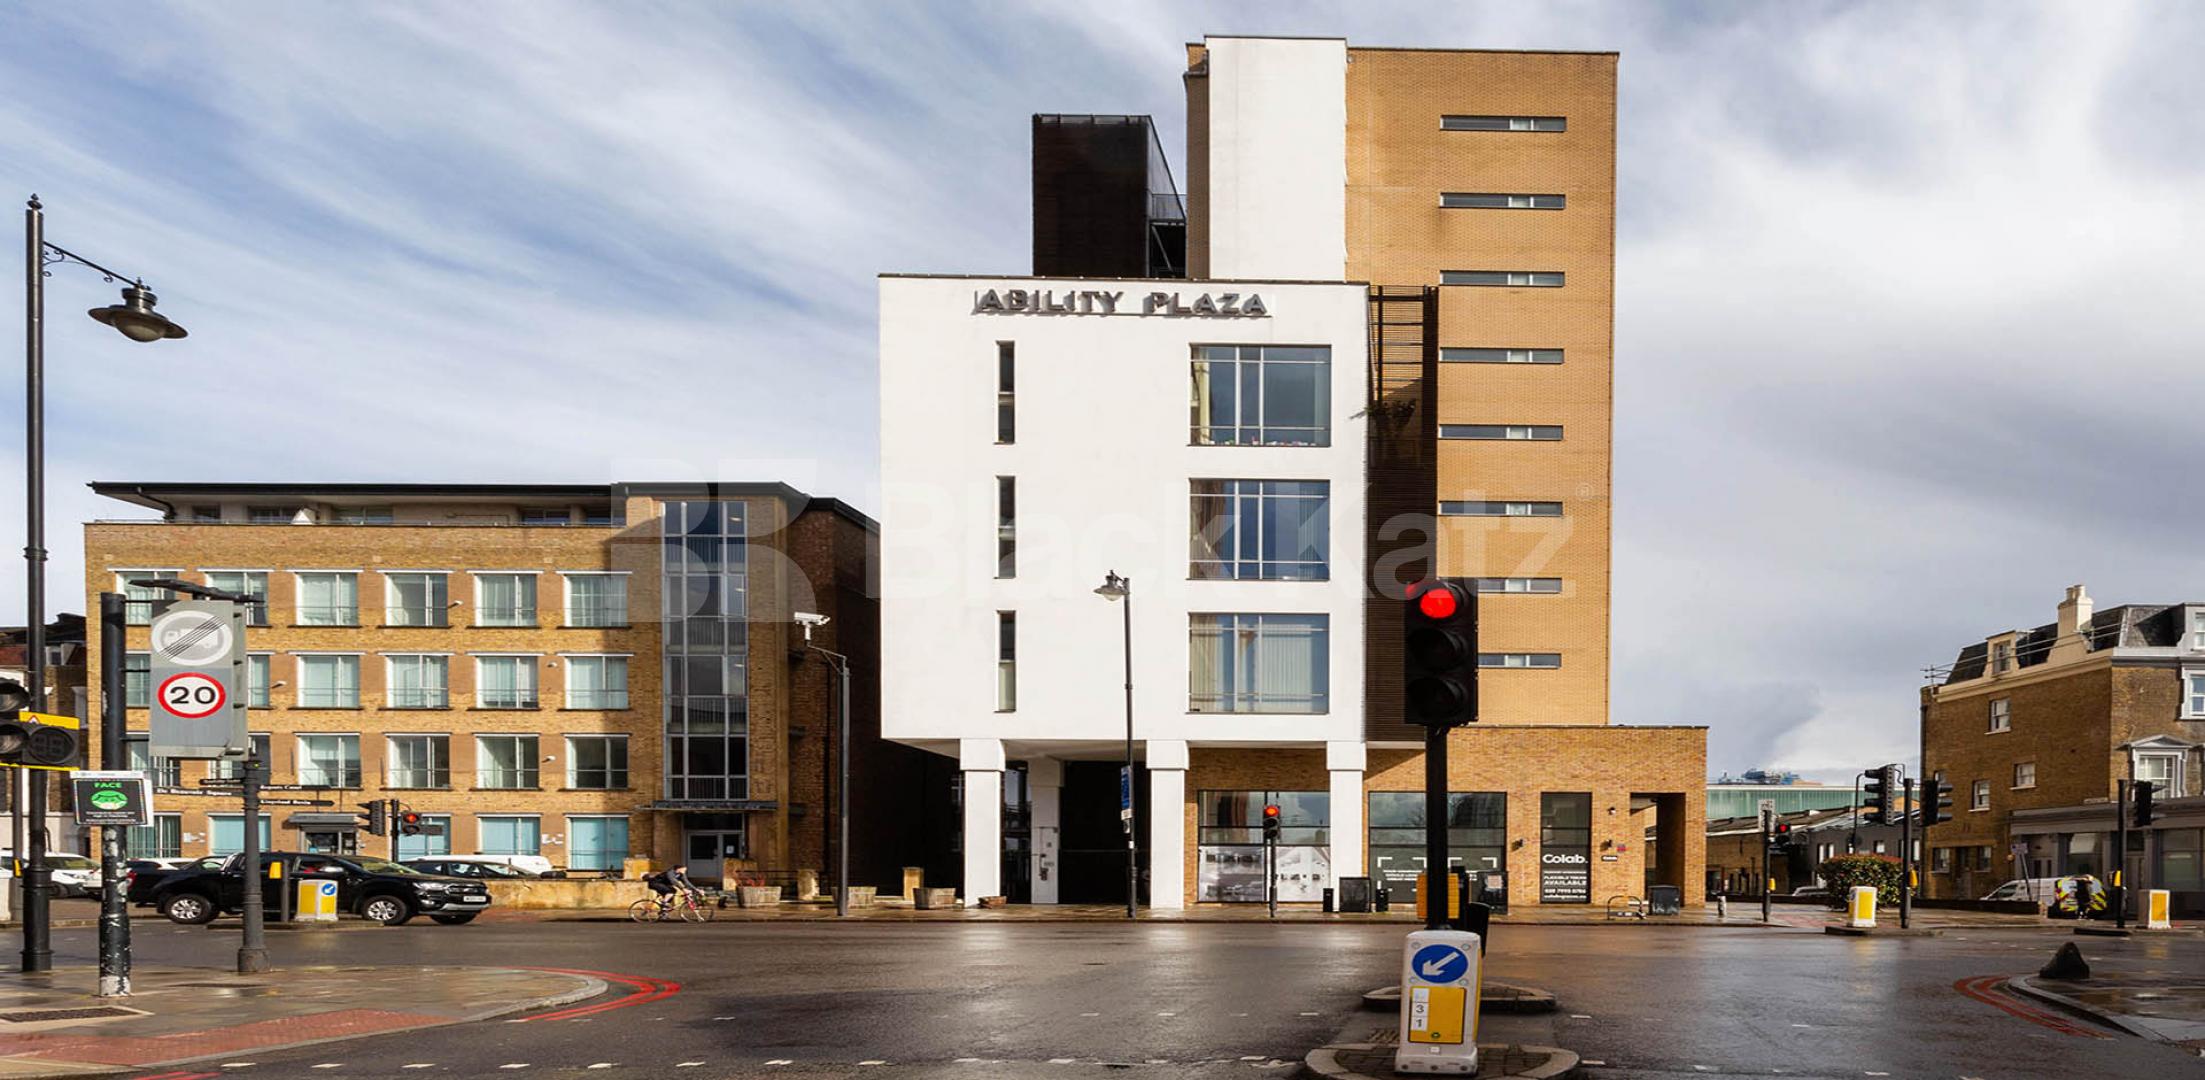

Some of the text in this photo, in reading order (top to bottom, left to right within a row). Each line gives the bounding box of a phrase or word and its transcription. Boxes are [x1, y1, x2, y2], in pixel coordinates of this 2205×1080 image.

[972, 289, 1268, 318] ABILITY PLAZA
[170, 686, 216, 704] 20
[1415, 1004, 1424, 1013] 3
[1416, 1018, 1422, 1027] 1
